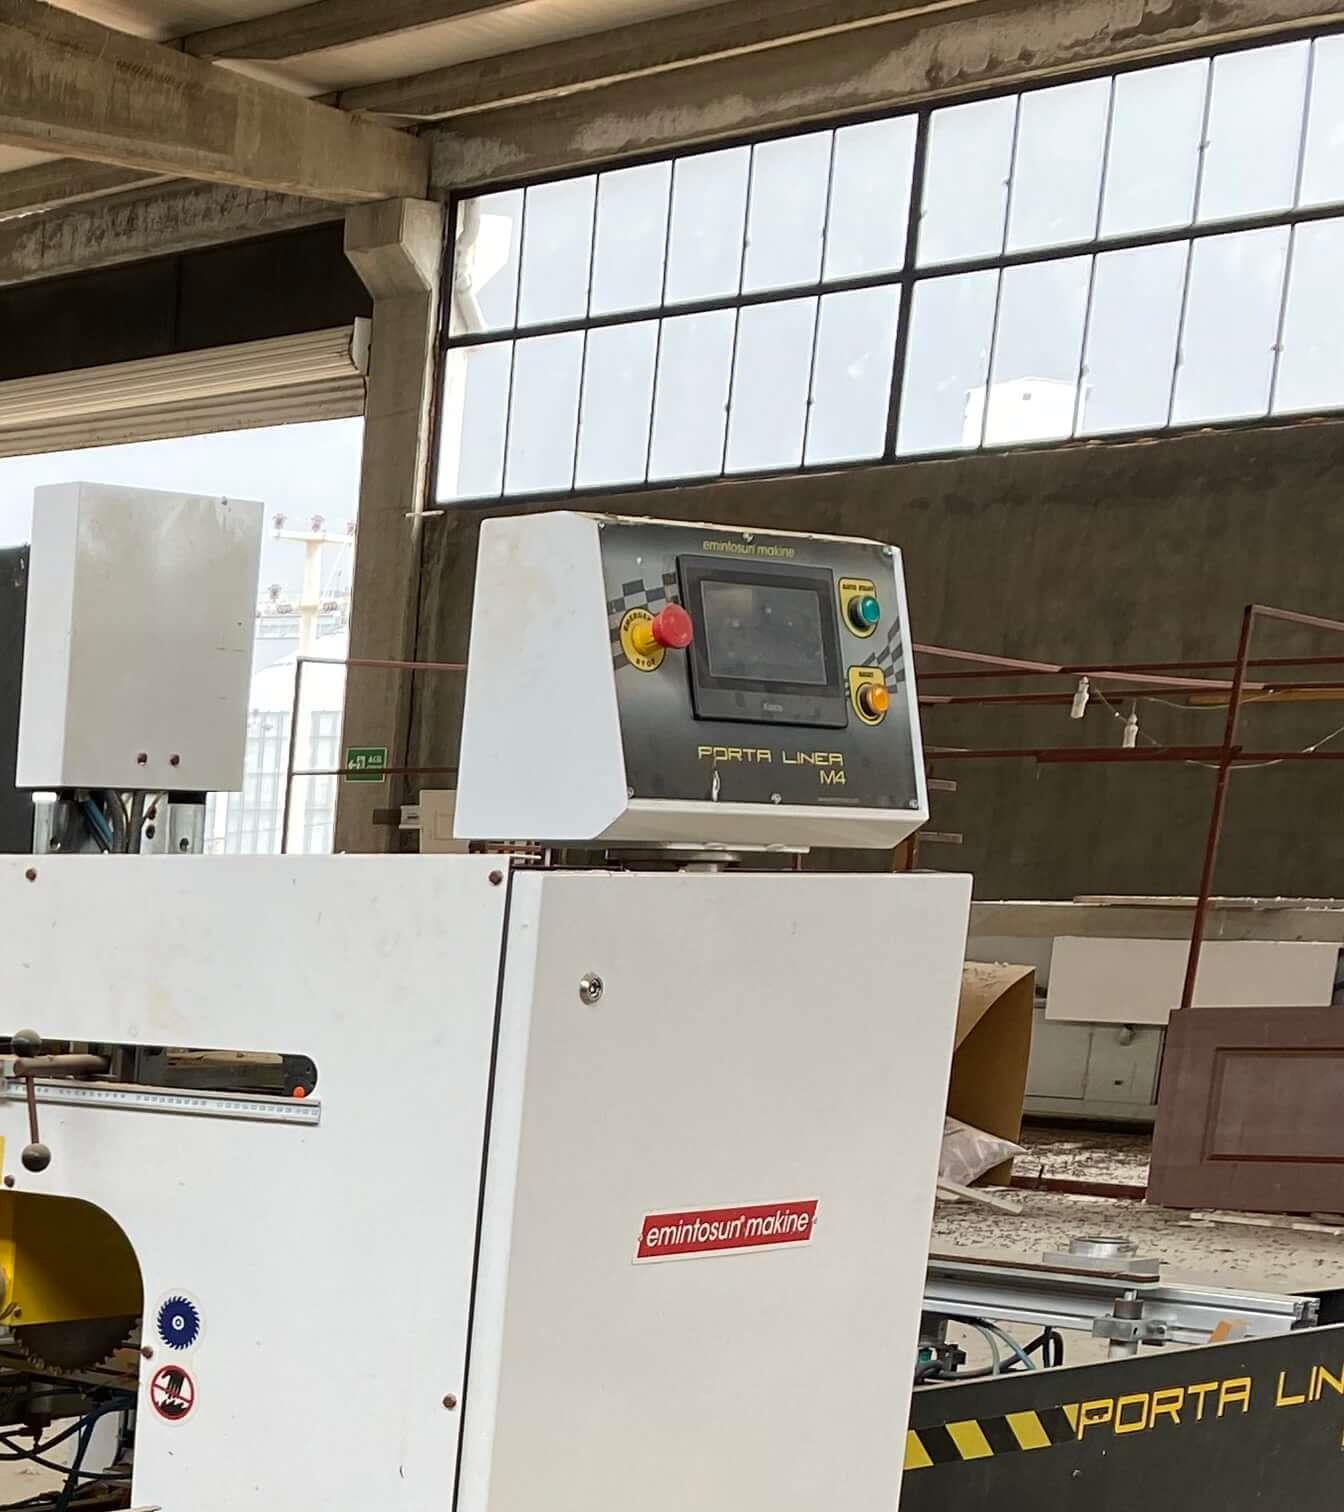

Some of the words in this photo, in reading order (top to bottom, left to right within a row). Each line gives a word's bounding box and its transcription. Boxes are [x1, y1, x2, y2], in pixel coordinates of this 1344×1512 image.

[697, 746, 772, 763] PORTA
[782, 751, 844, 766] LINEA
[819, 769, 847, 785] M4
[743, 1209, 809, 1238] makine
[1076, 1376, 1252, 1441] PORTA
